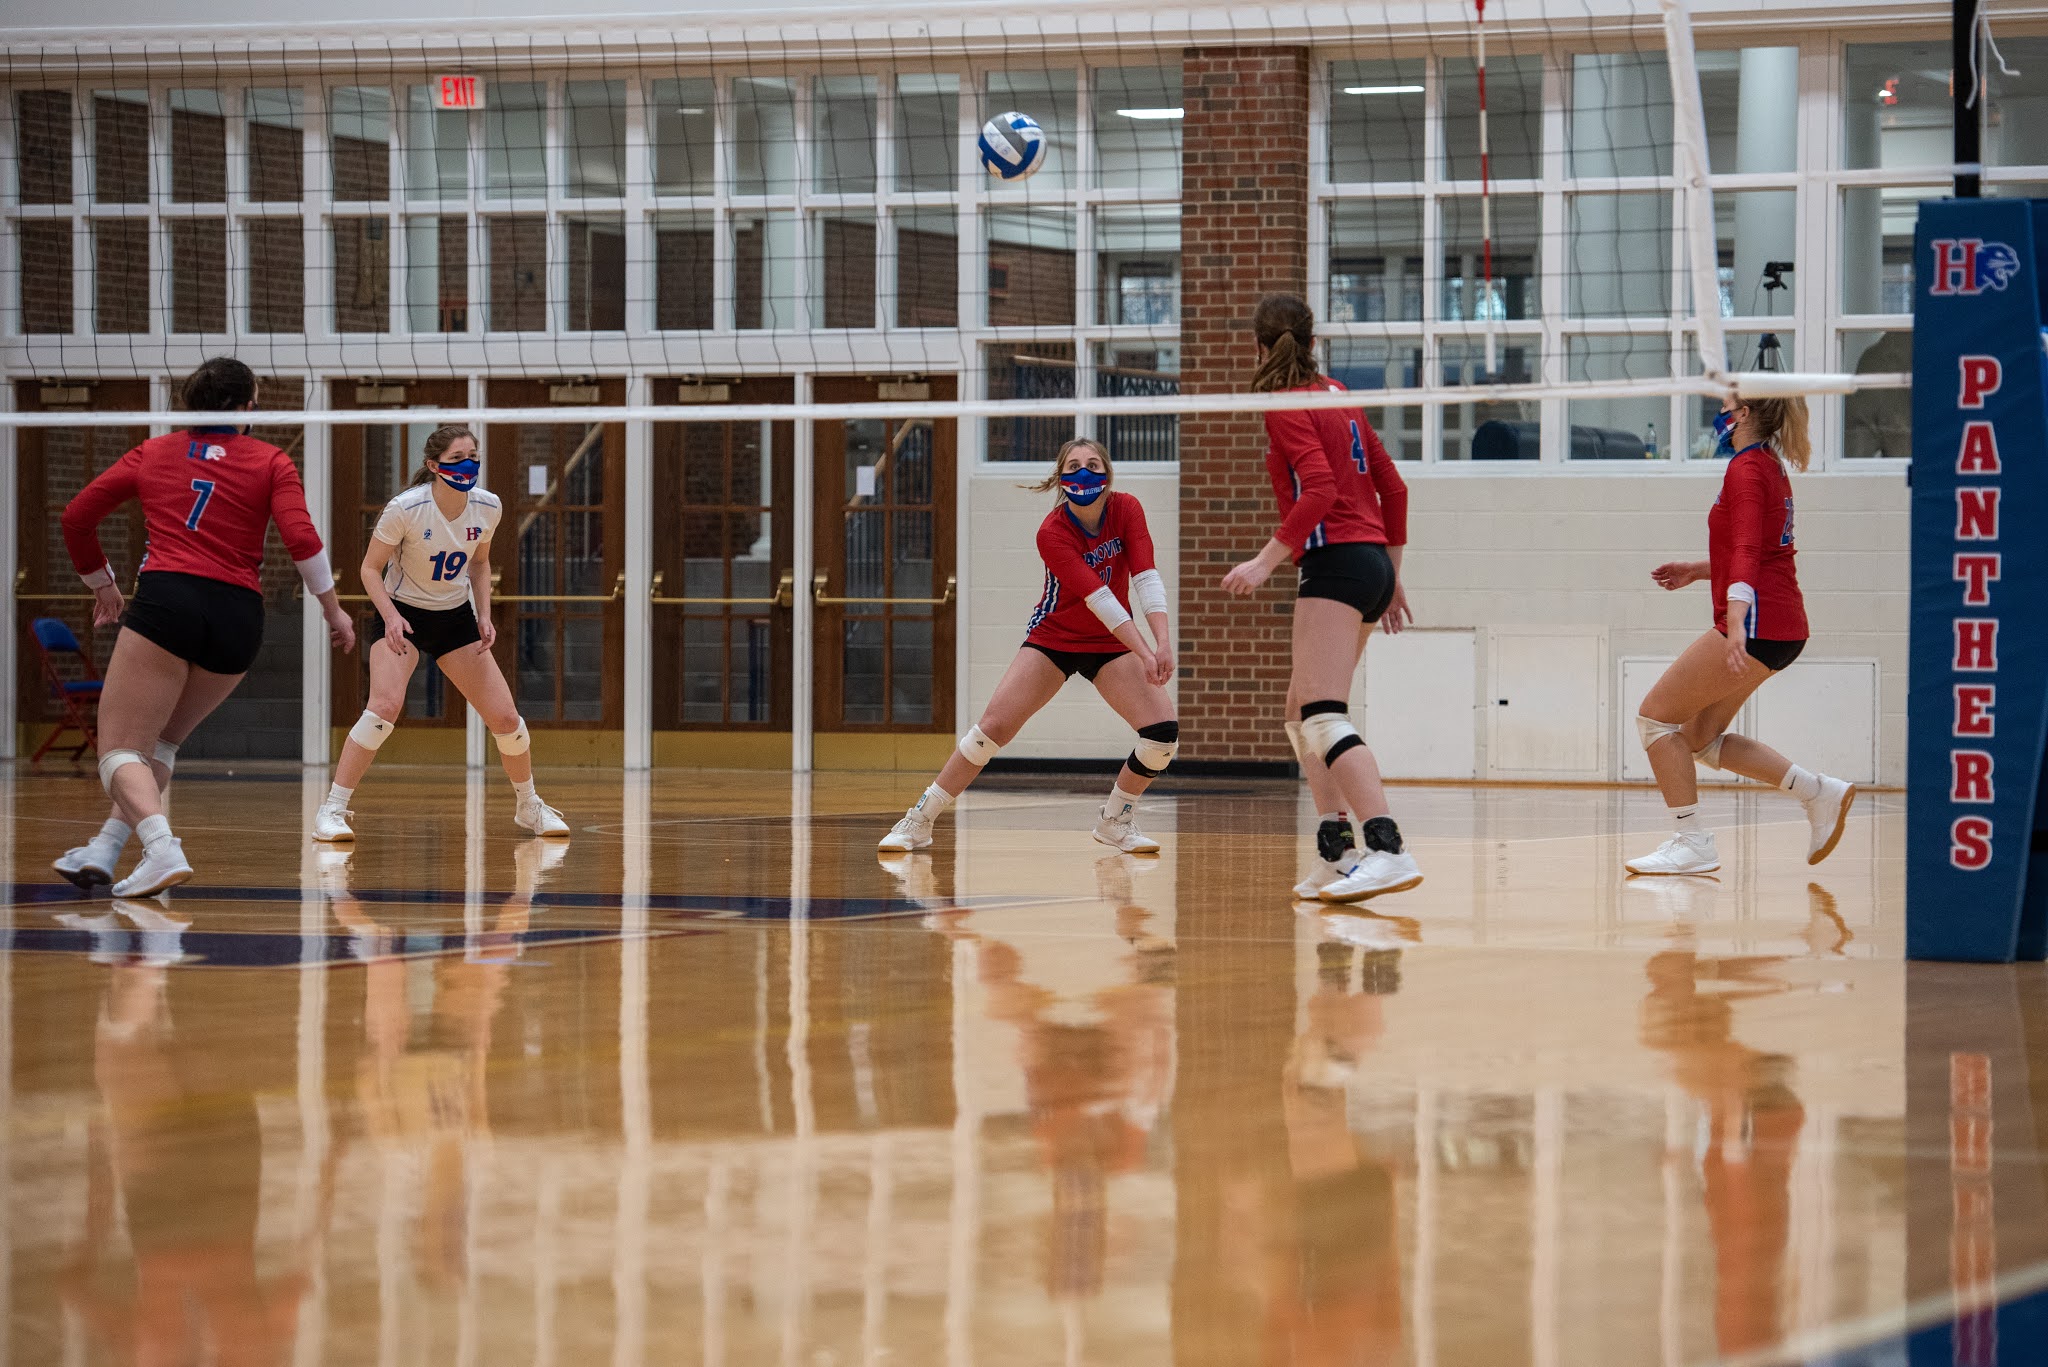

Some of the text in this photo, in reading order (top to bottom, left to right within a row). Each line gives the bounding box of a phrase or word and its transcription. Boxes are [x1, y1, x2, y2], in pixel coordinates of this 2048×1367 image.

[441, 76, 475, 106] EXIT
[1929, 238, 1983, 296] H
[1349, 419, 1367, 474] 4
[185, 478, 215, 531] 7
[429, 550, 468, 581] 19
[1083, 537, 1123, 568] ANOVR
[1949, 355, 2002, 871] PANTHERS
